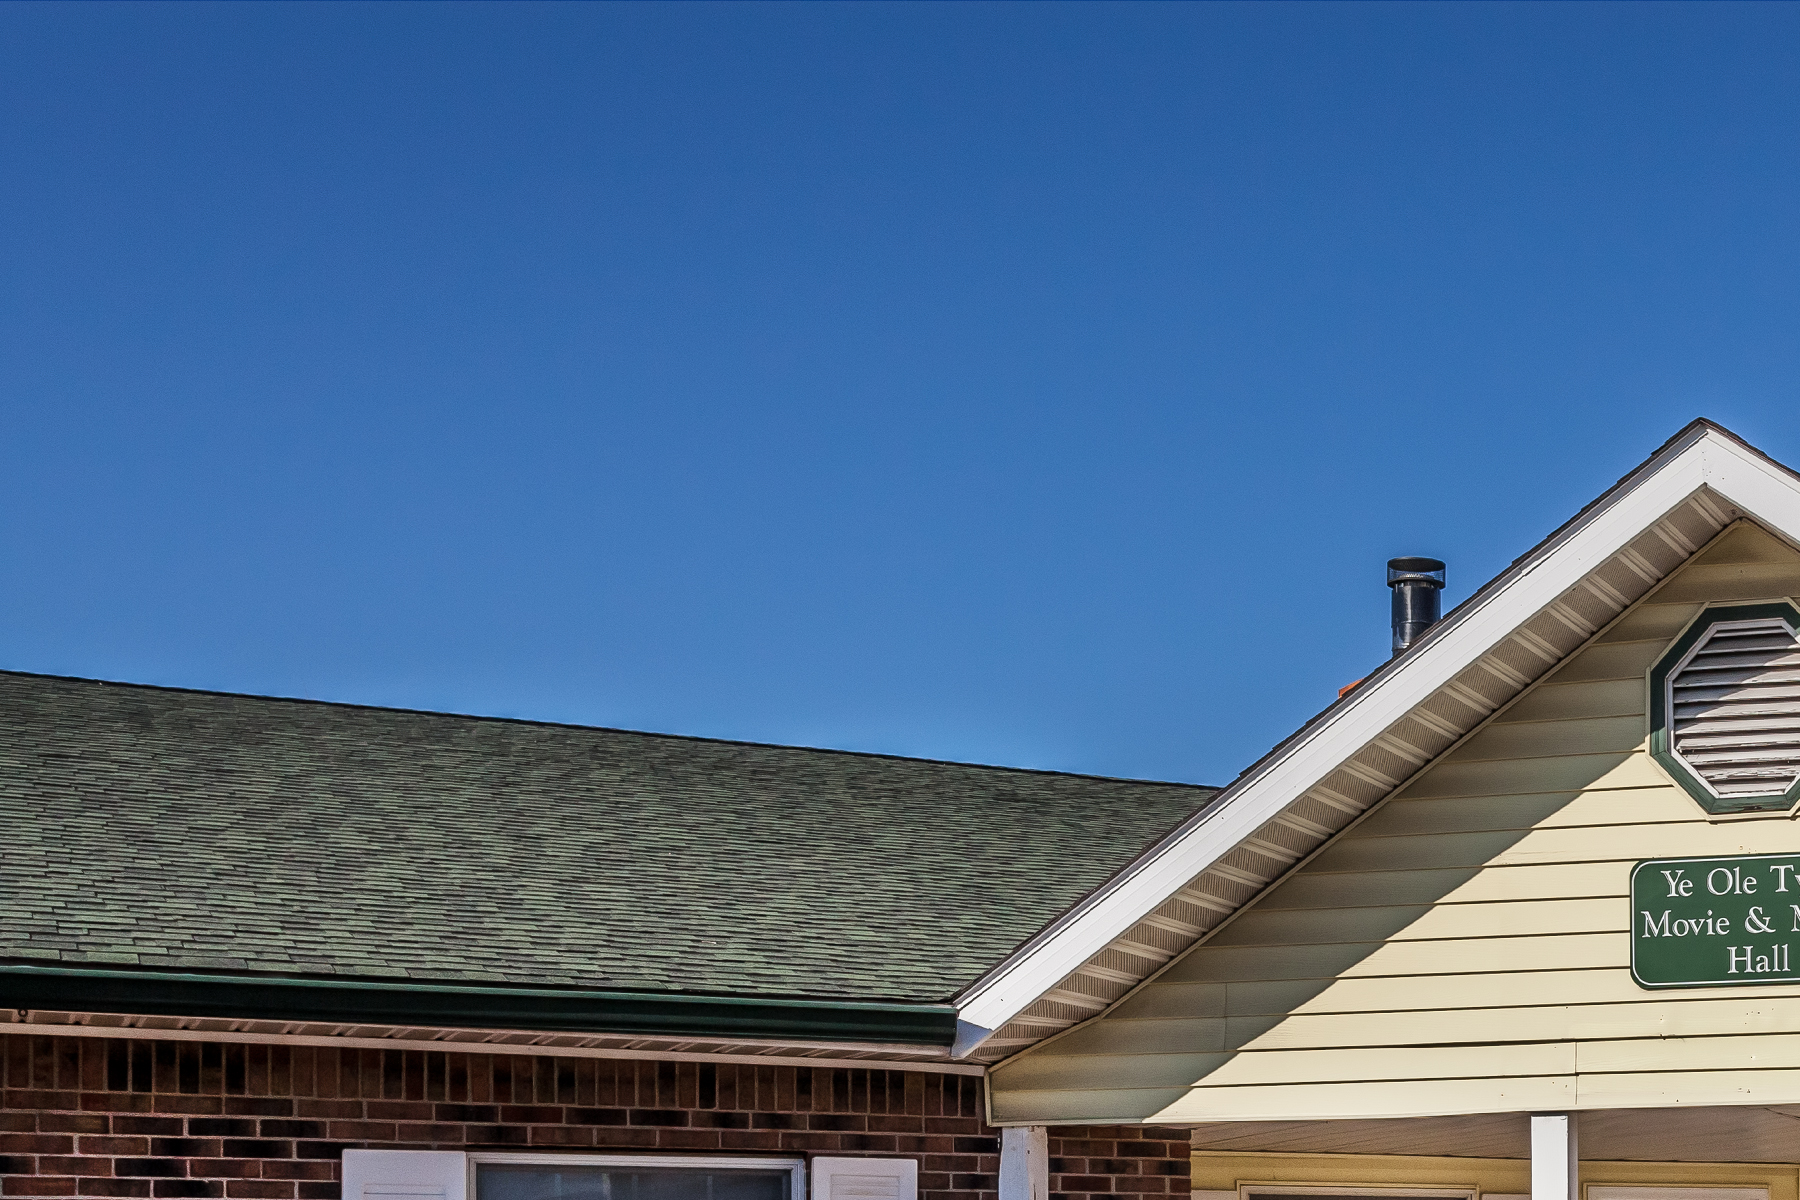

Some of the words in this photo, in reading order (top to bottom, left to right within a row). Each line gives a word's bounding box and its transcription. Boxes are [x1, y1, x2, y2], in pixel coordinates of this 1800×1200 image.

[1661, 869, 1693, 898] Ye
[1706, 866, 1757, 896] Ole
[1641, 909, 1730, 938] Movie
[1744, 906, 1776, 934] &
[1727, 943, 1791, 974] Hall
